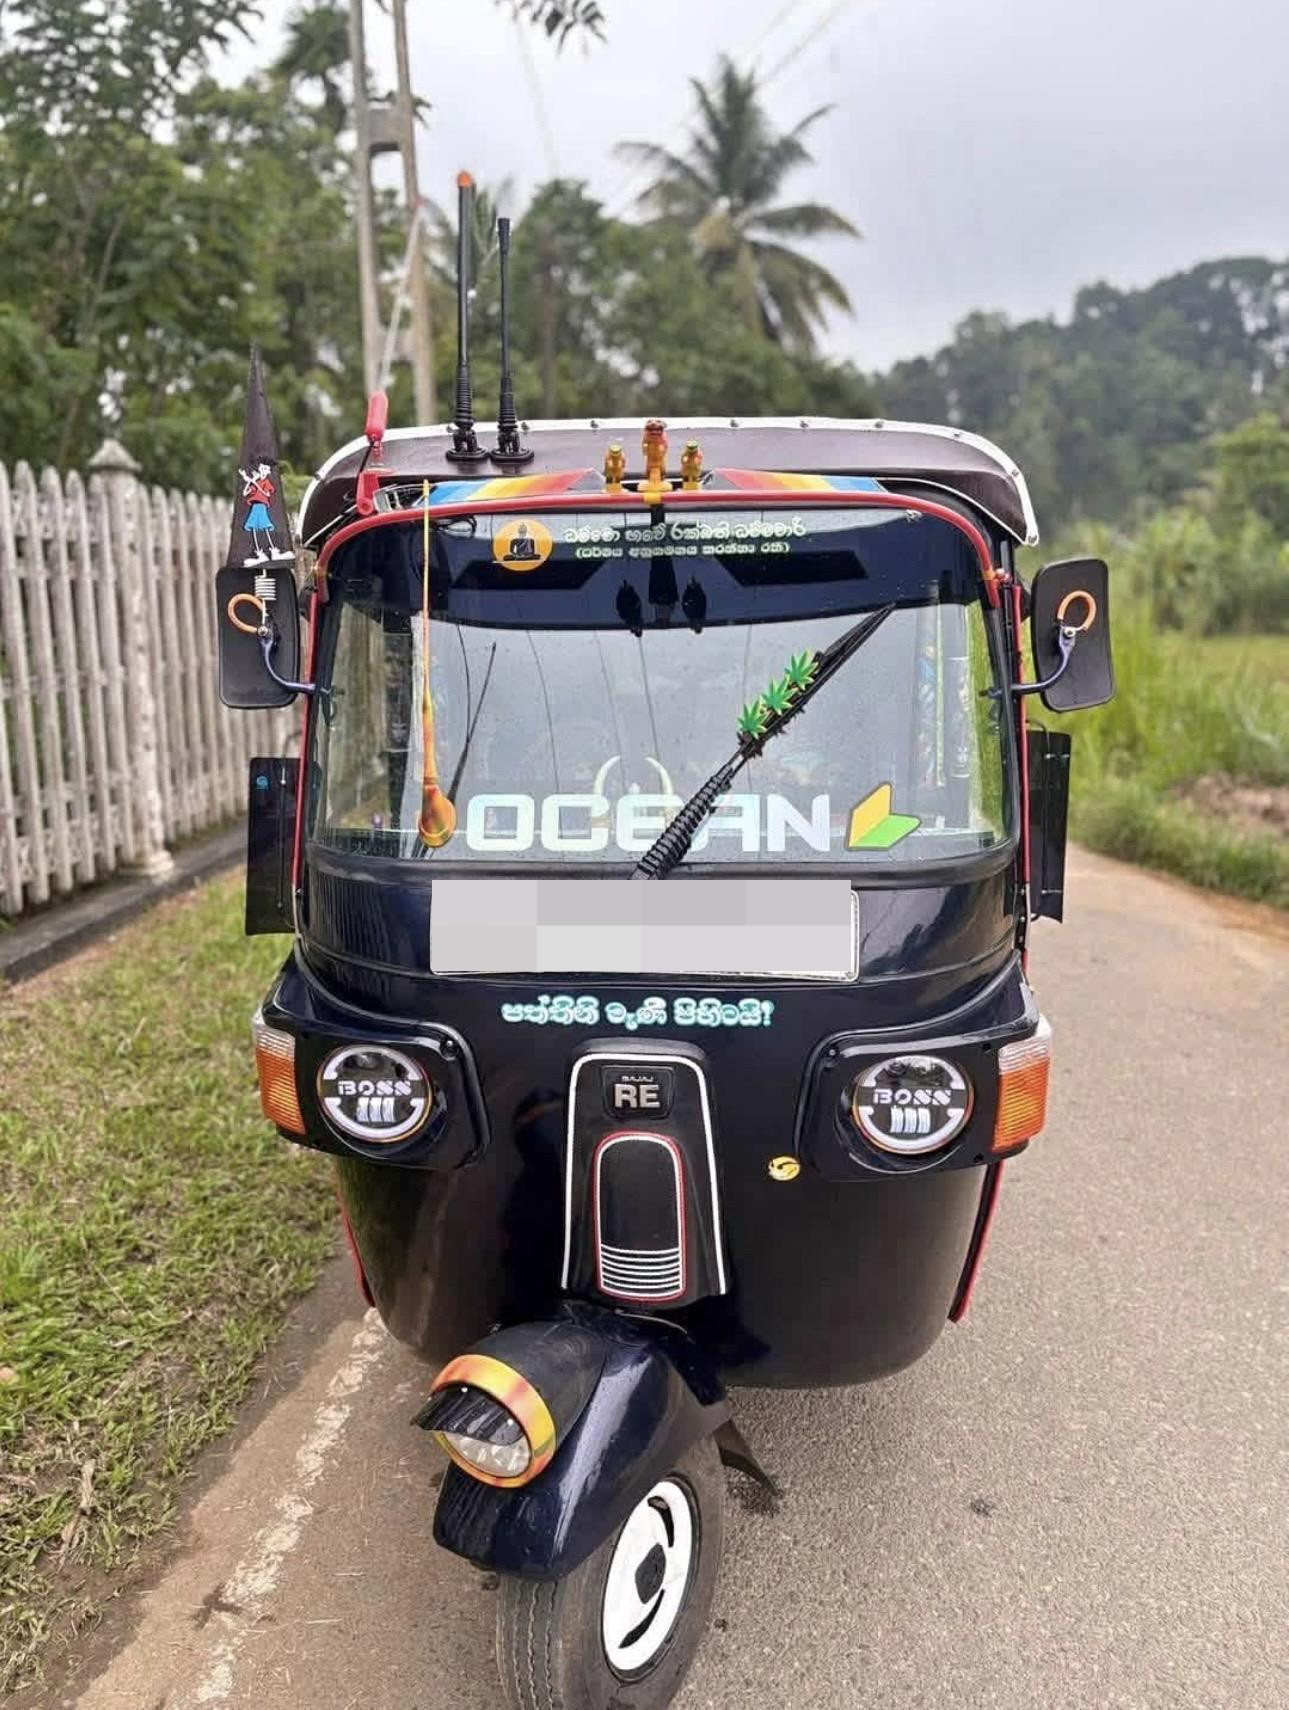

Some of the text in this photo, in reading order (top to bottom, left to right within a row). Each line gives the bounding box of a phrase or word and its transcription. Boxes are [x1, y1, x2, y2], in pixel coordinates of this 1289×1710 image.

[466, 793, 832, 852] OCEAN
[337, 1080, 412, 1096] BOSS
[614, 1083, 660, 1108] RE
[873, 1088, 952, 1106] BOSS
